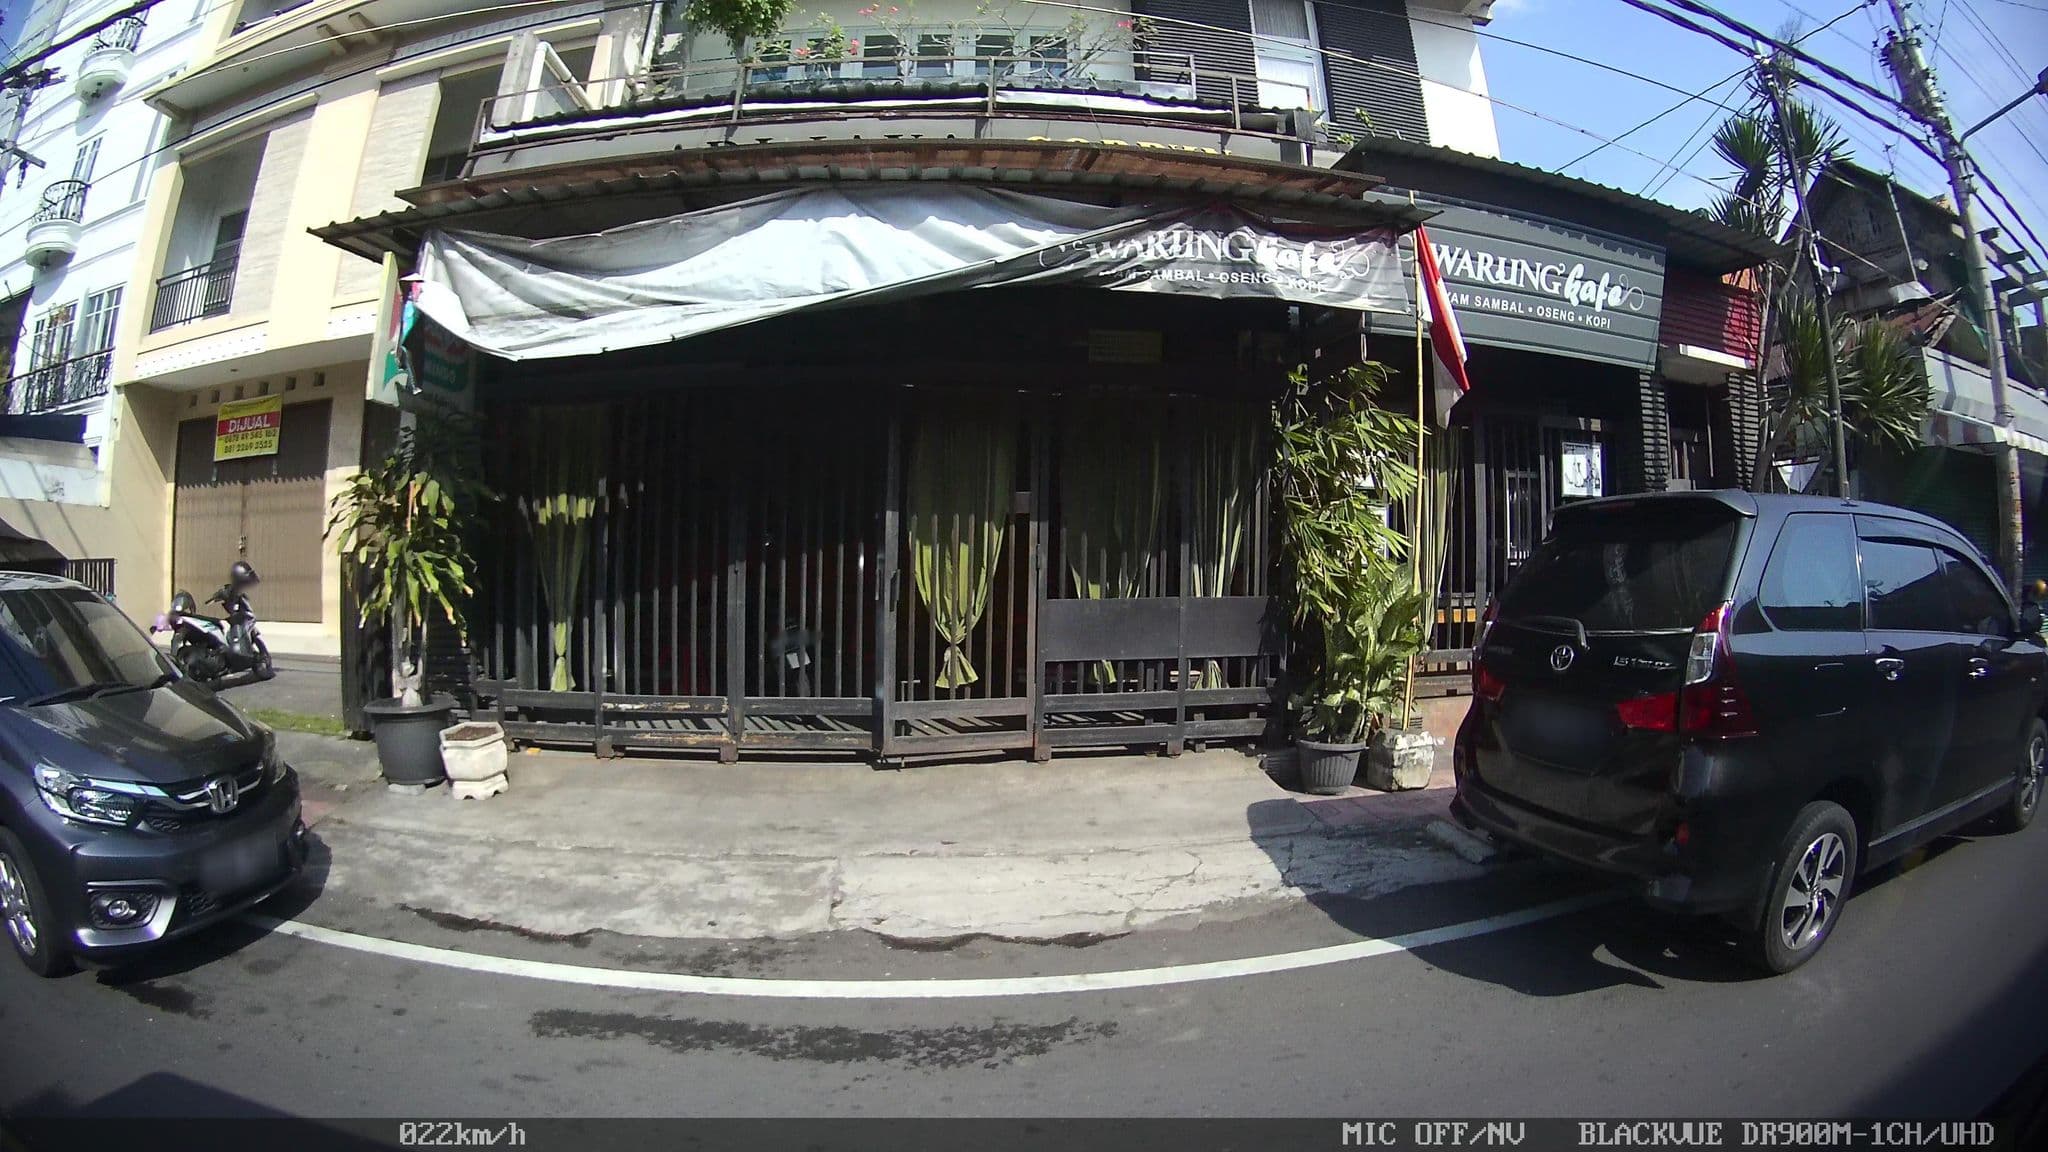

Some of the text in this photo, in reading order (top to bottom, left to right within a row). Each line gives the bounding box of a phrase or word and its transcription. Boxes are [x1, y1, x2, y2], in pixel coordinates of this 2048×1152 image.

[1087, 226, 1256, 263] WARUNG
[1219, 271, 1273, 284] OSENG
[1429, 242, 1626, 312] WARUNG kafe
[1447, 290, 1612, 330] YAM SAMBAL OSENG KOPI
[228, 414, 271, 433] DIJUAL
